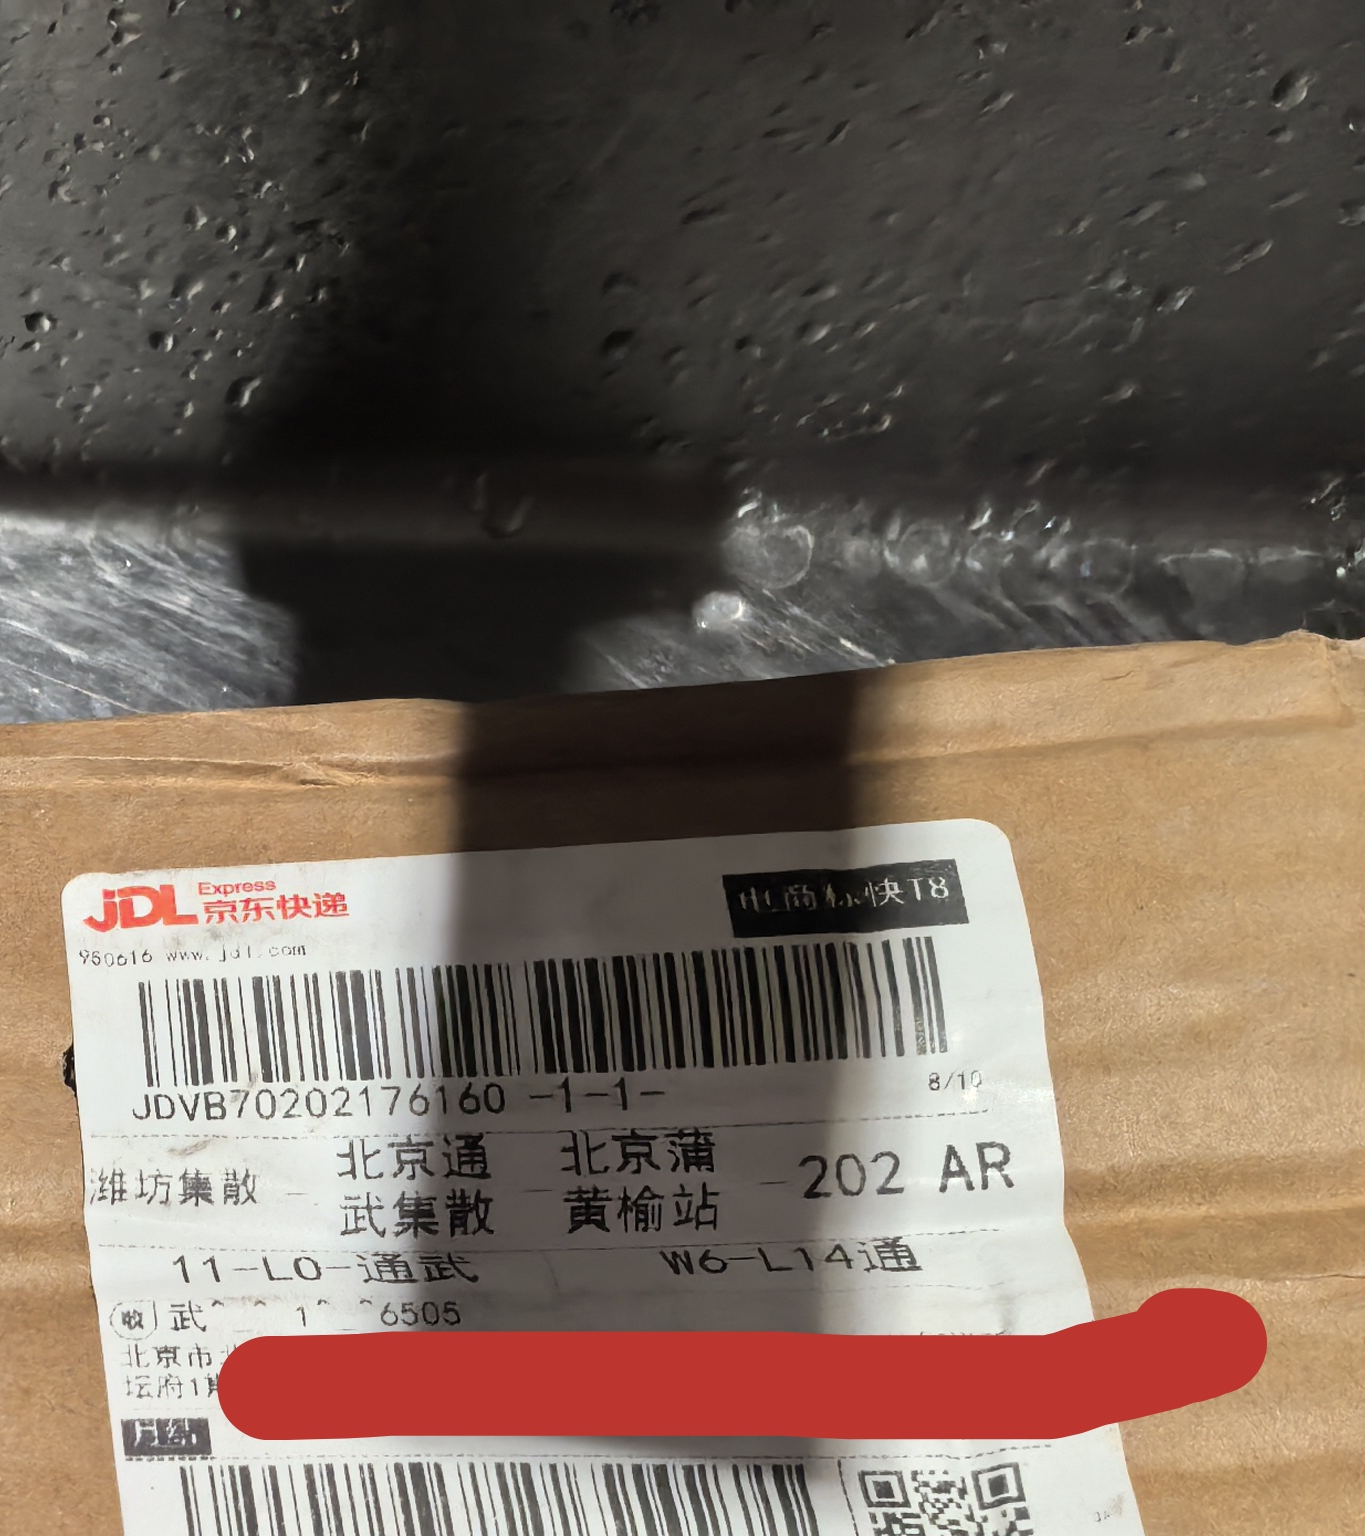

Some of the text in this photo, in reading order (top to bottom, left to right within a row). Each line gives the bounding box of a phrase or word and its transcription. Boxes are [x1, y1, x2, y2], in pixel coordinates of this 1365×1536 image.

[83, 880, 277, 933] JDL Express
[203, 891, 350, 926] 京东快递
[928, 1070, 982, 1091] 8/10
[336, 1133, 493, 1181] 北京通
[560, 1128, 716, 1177] 北京蒲
[798, 1142, 1016, 1200] 202 AR
[89, 1166, 259, 1208] 潍坊集散
[562, 1181, 721, 1235] 黄榆站
[339, 1190, 496, 1239] 武集散
[121, 1343, 235, 1370] 北京市
